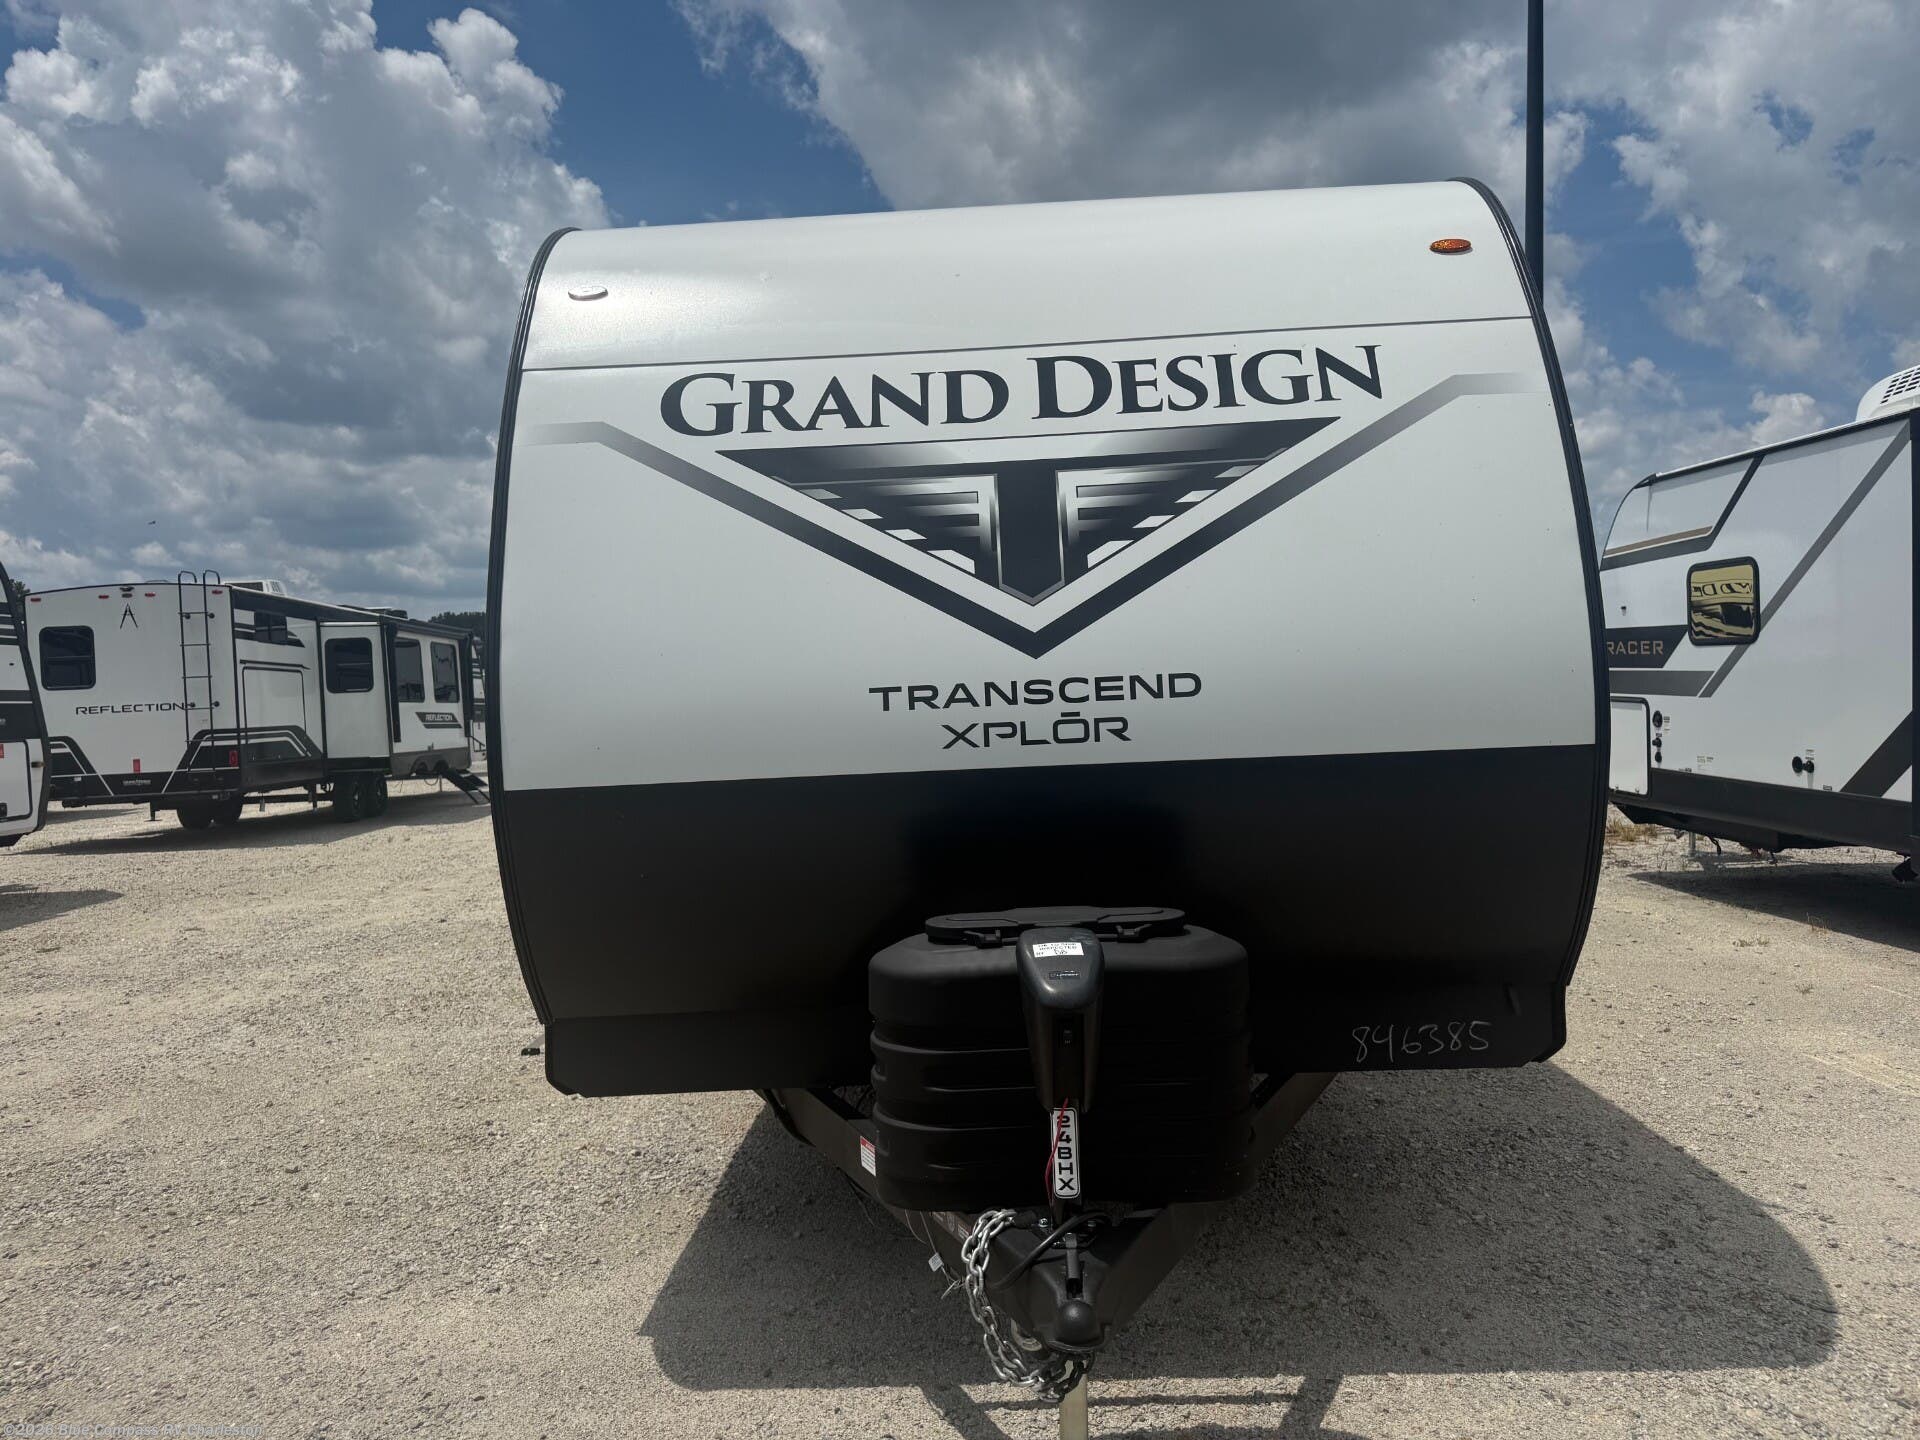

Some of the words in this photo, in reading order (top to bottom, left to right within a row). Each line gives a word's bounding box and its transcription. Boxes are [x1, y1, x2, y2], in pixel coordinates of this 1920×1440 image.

[660, 369, 1010, 437] GRAND
[1026, 344, 1383, 420] DESIGN
[75, 702, 186, 716] REFLECTION
[868, 672, 1203, 712] TRANSCEND
[940, 711, 1133, 750] XPLŌR
[1351, 1019, 1494, 1064] 846385
